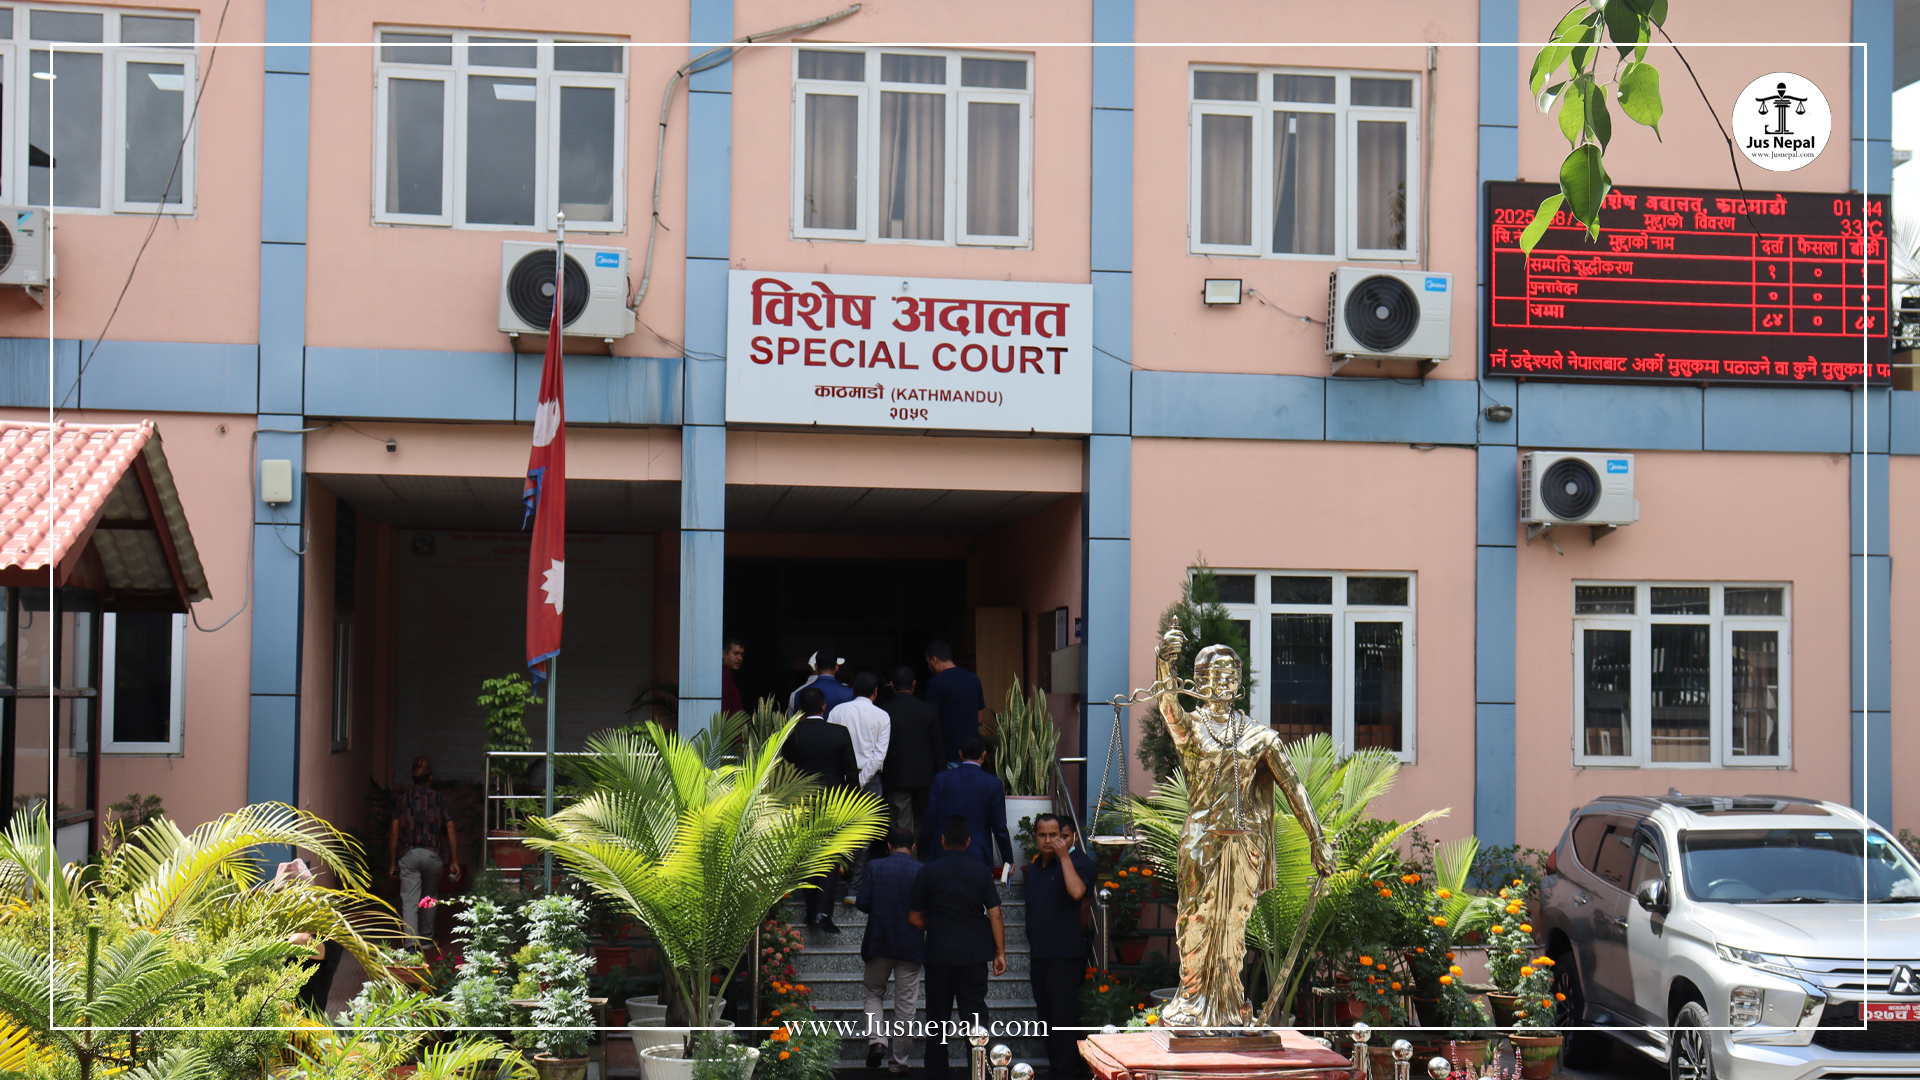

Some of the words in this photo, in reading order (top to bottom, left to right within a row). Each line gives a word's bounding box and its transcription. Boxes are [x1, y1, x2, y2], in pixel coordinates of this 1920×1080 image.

[1694, 212, 1736, 230] विवरण
[1650, 236, 1675, 250] नाम
[1760, 236, 1784, 255] दर्ता
[751, 278, 876, 331] विशेष
[892, 296, 1070, 338] अदालत
[750, 336, 918, 369] SPECIAL
[932, 342, 1068, 375] COURT
[1567, 350, 1628, 371] नेपालबाट
[1667, 358, 1720, 377] मुलुकमा
[1723, 356, 1771, 375] पठाउने
[1774, 362, 1789, 376] वा
[1792, 356, 1818, 380] कुनै
[891, 388, 1003, 406] (KATHMANDU)
[890, 408, 928, 421] २०५९
